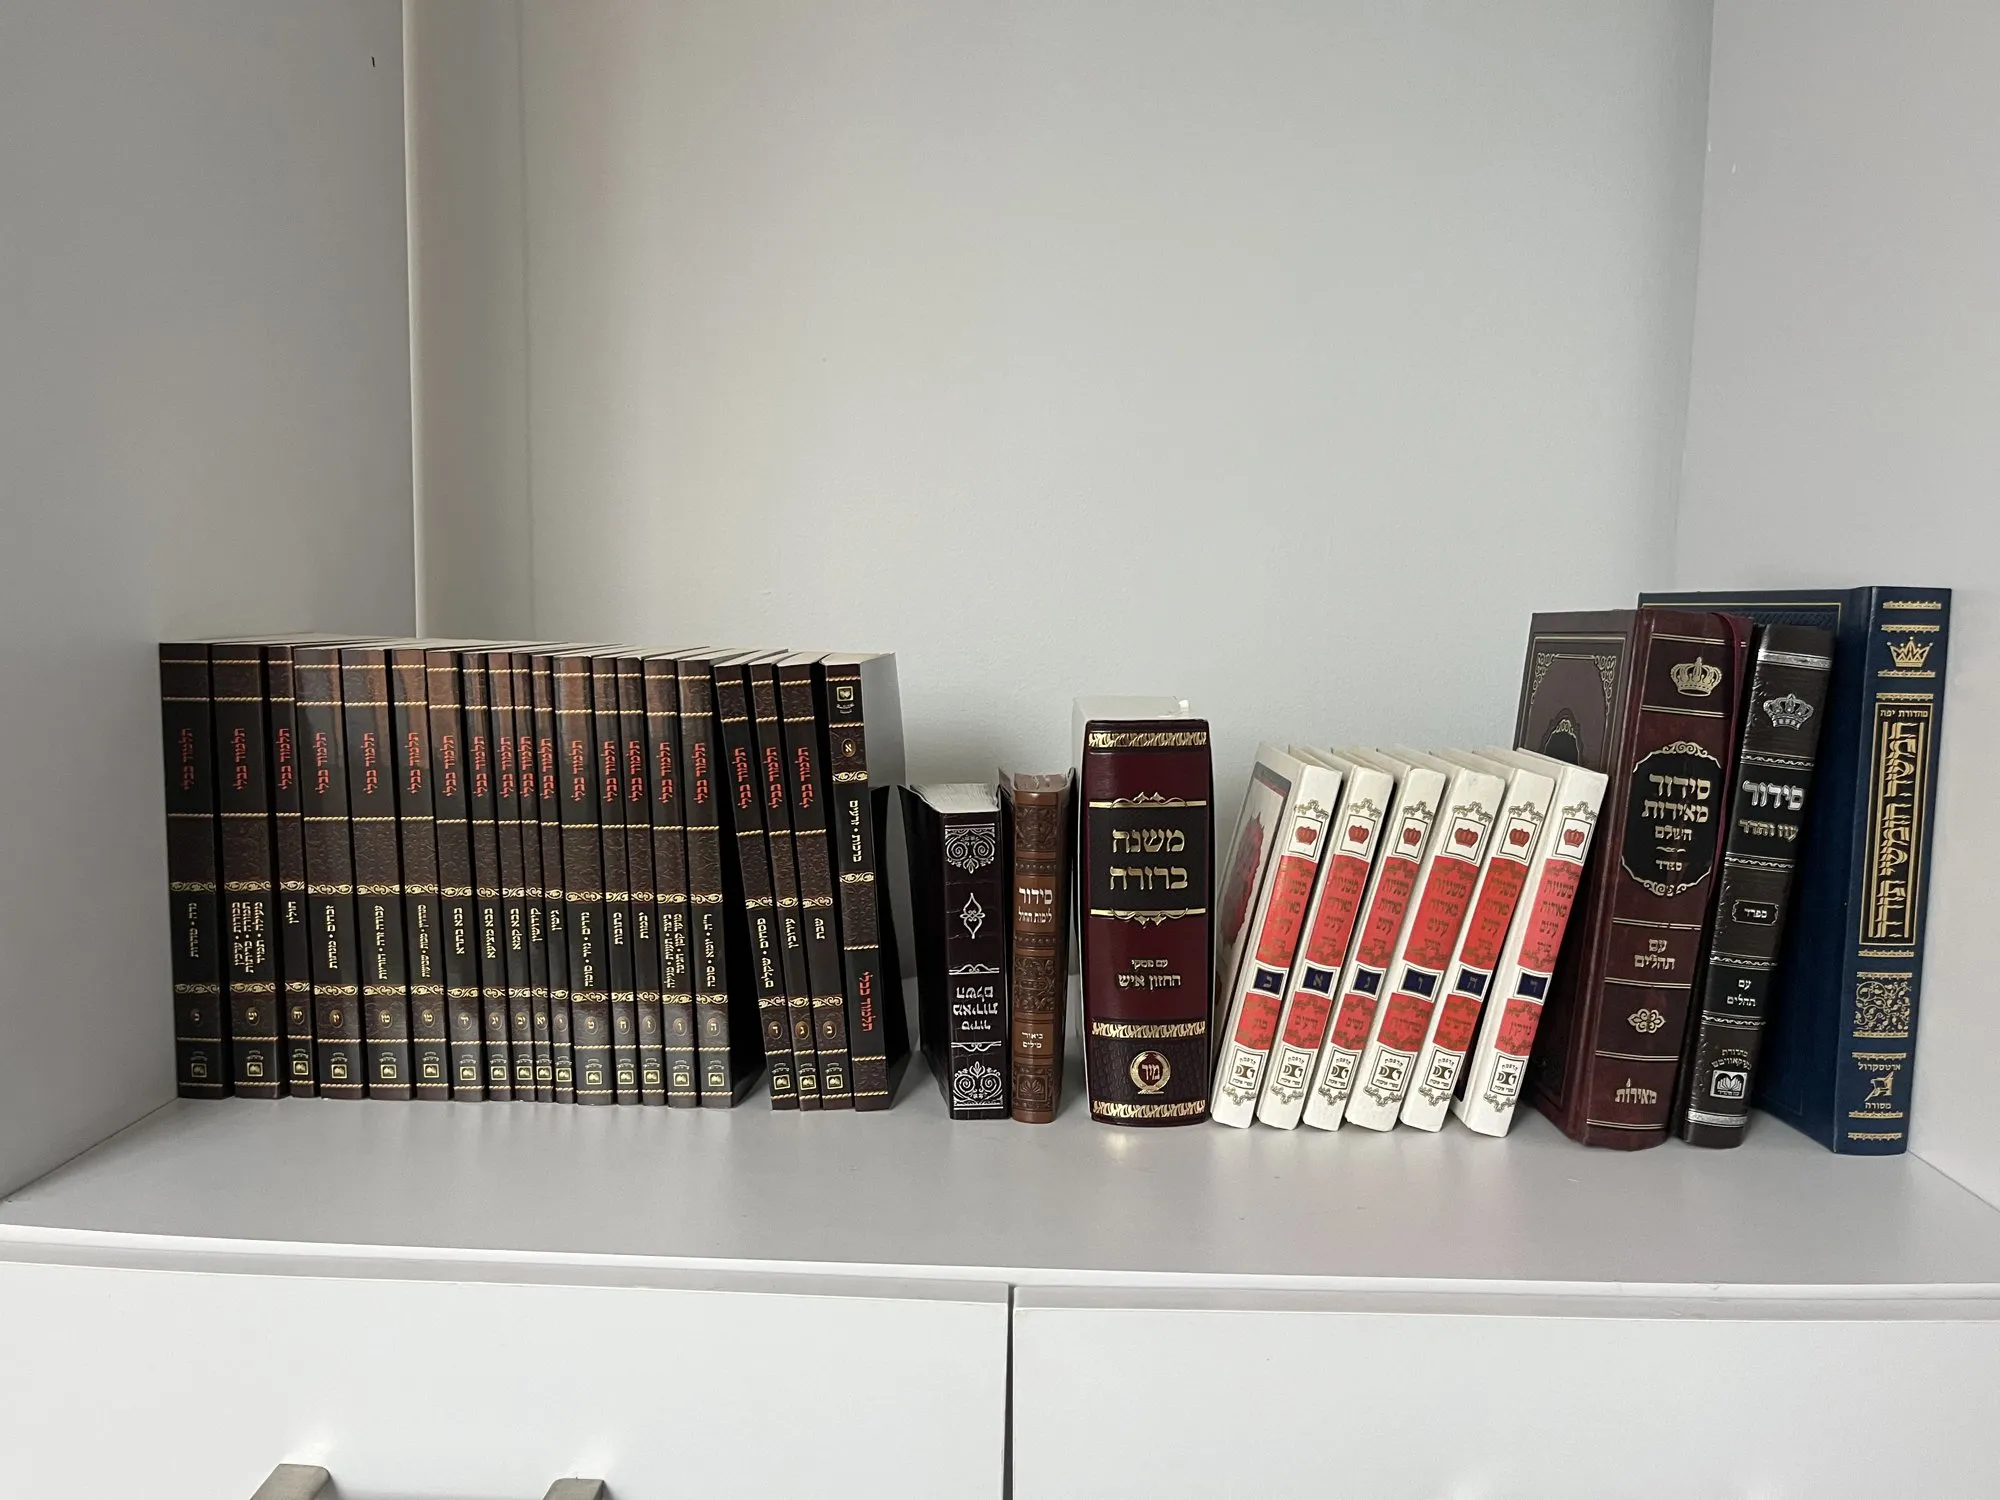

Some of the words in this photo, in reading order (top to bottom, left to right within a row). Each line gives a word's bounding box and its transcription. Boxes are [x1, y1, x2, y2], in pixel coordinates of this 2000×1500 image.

[1879, 708, 1896, 719] יפה
[1898, 708, 1929, 718] מהדורת
[179, 728, 193, 762] תלמוד
[231, 728, 245, 762] תלמוד
[276, 728, 290, 762] תלמוד
[312, 732, 326, 766] תלמוד
[360, 732, 375, 766] תלמוד
[404, 732, 419, 766] תלמוד
[440, 736, 454, 770] תלמוד
[470, 736, 485, 770] תלמוד
[497, 736, 511, 770] תלמוד
[518, 736, 532, 770] תלמוד
[538, 738, 552, 772] תלמוד
[568, 740, 584, 774] תלמוד
[600, 740, 616, 774] תלמוד
[626, 740, 640, 774] תלמוד
[846, 744, 852, 752] א
[656, 742, 671, 776] תלמוד
[692, 742, 706, 777] תלמוד
[732, 747, 748, 782] תלמוד
[763, 747, 779, 782] תלמוד
[794, 747, 810, 782] תלמוד
[1884, 722, 1917, 798] חמשה
[180, 765, 194, 790] בבלי
[232, 765, 247, 790] בבלי
[278, 765, 293, 790] בבלי
[315, 769, 330, 794] בבלי
[364, 769, 377, 794] בבלי
[408, 769, 421, 794] בבלי
[442, 772, 456, 797] בבלי
[473, 773, 487, 798] בבלי
[500, 773, 514, 798] בבלי
[520, 773, 534, 798] בבלי
[540, 774, 554, 800] בבלי
[571, 776, 585, 802] בבלי
[604, 777, 618, 802] בבלי
[629, 777, 644, 802] בבלי
[1648, 773, 1712, 800] סידור
[659, 778, 672, 803] בבלי
[694, 779, 708, 804] בבלי
[738, 784, 752, 808] בבלי
[768, 784, 782, 808] בבלי
[800, 784, 814, 808] בבלי
[1742, 780, 1806, 811] סידור
[848, 800, 860, 826] זרעים
[1642, 798, 1709, 823] מאירות
[1112, 828, 1184, 853] משנה
[1654, 824, 1692, 842] השלם
[1738, 818, 1776, 838] והדר
[1776, 824, 1799, 842] עוז
[1878, 802, 1912, 878] חומשי
[852, 834, 862, 862] ברכות
[1110, 866, 1188, 890] ברורה
[1656, 859, 1682, 872] ספרד
[1018, 886, 1053, 904] סידור
[232, 902, 242, 933] בכורות
[242, 902, 252, 932] תמורה
[252, 902, 264, 930] מעילה
[286, 902, 299, 924] חולין
[326, 906, 336, 932] זבחים
[374, 905, 384, 930] עבודה
[454, 908, 463, 926] בבא
[484, 908, 494, 927] בבא
[510, 908, 520, 927] בבא
[550, 910, 562, 931] גיטין
[1018, 906, 1032, 922] החול
[1034, 907, 1052, 923] לימות
[1744, 907, 1768, 918] ספרד
[1873, 880, 1906, 939] תורה
[530, 908, 542, 942] קידושין
[581, 912, 591, 934] נדרים
[613, 912, 624, 945] כתובות
[639, 912, 649, 939] יבמות
[662, 914, 672, 932] ביצה
[673, 914, 682, 931] מועד
[756, 918, 769, 948] פסחים
[786, 918, 799, 948] עירובין
[814, 918, 826, 940] שבת
[376, 932, 384, 946] זרה
[420, 933, 429, 949] מכות
[456, 928, 464, 954] בתרא
[486, 929, 496, 958] מציעא
[512, 929, 522, 950] קמא
[583, 942, 592, 958] נזיר
[664, 938, 674, 960] תענית
[674, 932, 686, 947] קטן
[704, 938, 714, 958] יומא
[1648, 938, 1668, 953] עם
[234, 942, 244, 966] ערכין
[245, 941, 254, 973] כריתות
[256, 940, 266, 964] תמיד
[328, 941, 338, 968] מנחות
[676, 954, 685, 974] חגיגה
[1130, 958, 1154, 970] פסקי
[1156, 959, 1168, 968] עם
[1634, 954, 1676, 970] תהלים
[378, 954, 388, 979] הוריות
[584, 965, 594, 987] סוטה
[664, 966, 675, 988] מגילה
[706, 966, 716, 987] סוכה
[760, 958, 774, 988] שקלים
[859, 972, 873, 995] בבלי
[1118, 974, 1146, 988] איש
[1149, 974, 1181, 991] החזון
[1262, 976, 1273, 988] ב
[1312, 974, 1324, 987] א
[1364, 976, 1371, 988] ג
[1467, 976, 1478, 989] ה
[1530, 980, 1538, 992] ד
[1738, 978, 1752, 990] עם
[956, 986, 994, 1003] השלם
[1726, 994, 1756, 1007] תהלים
[861, 997, 876, 1031] תלמוד
[953, 1002, 999, 1016] מאירות
[962, 1020, 991, 1030] סידור
[1858, 1062, 1901, 1072] ארטסקרול
[1614, 1078, 1658, 1105] מאירות
[1864, 1102, 1892, 1110] מסורה
